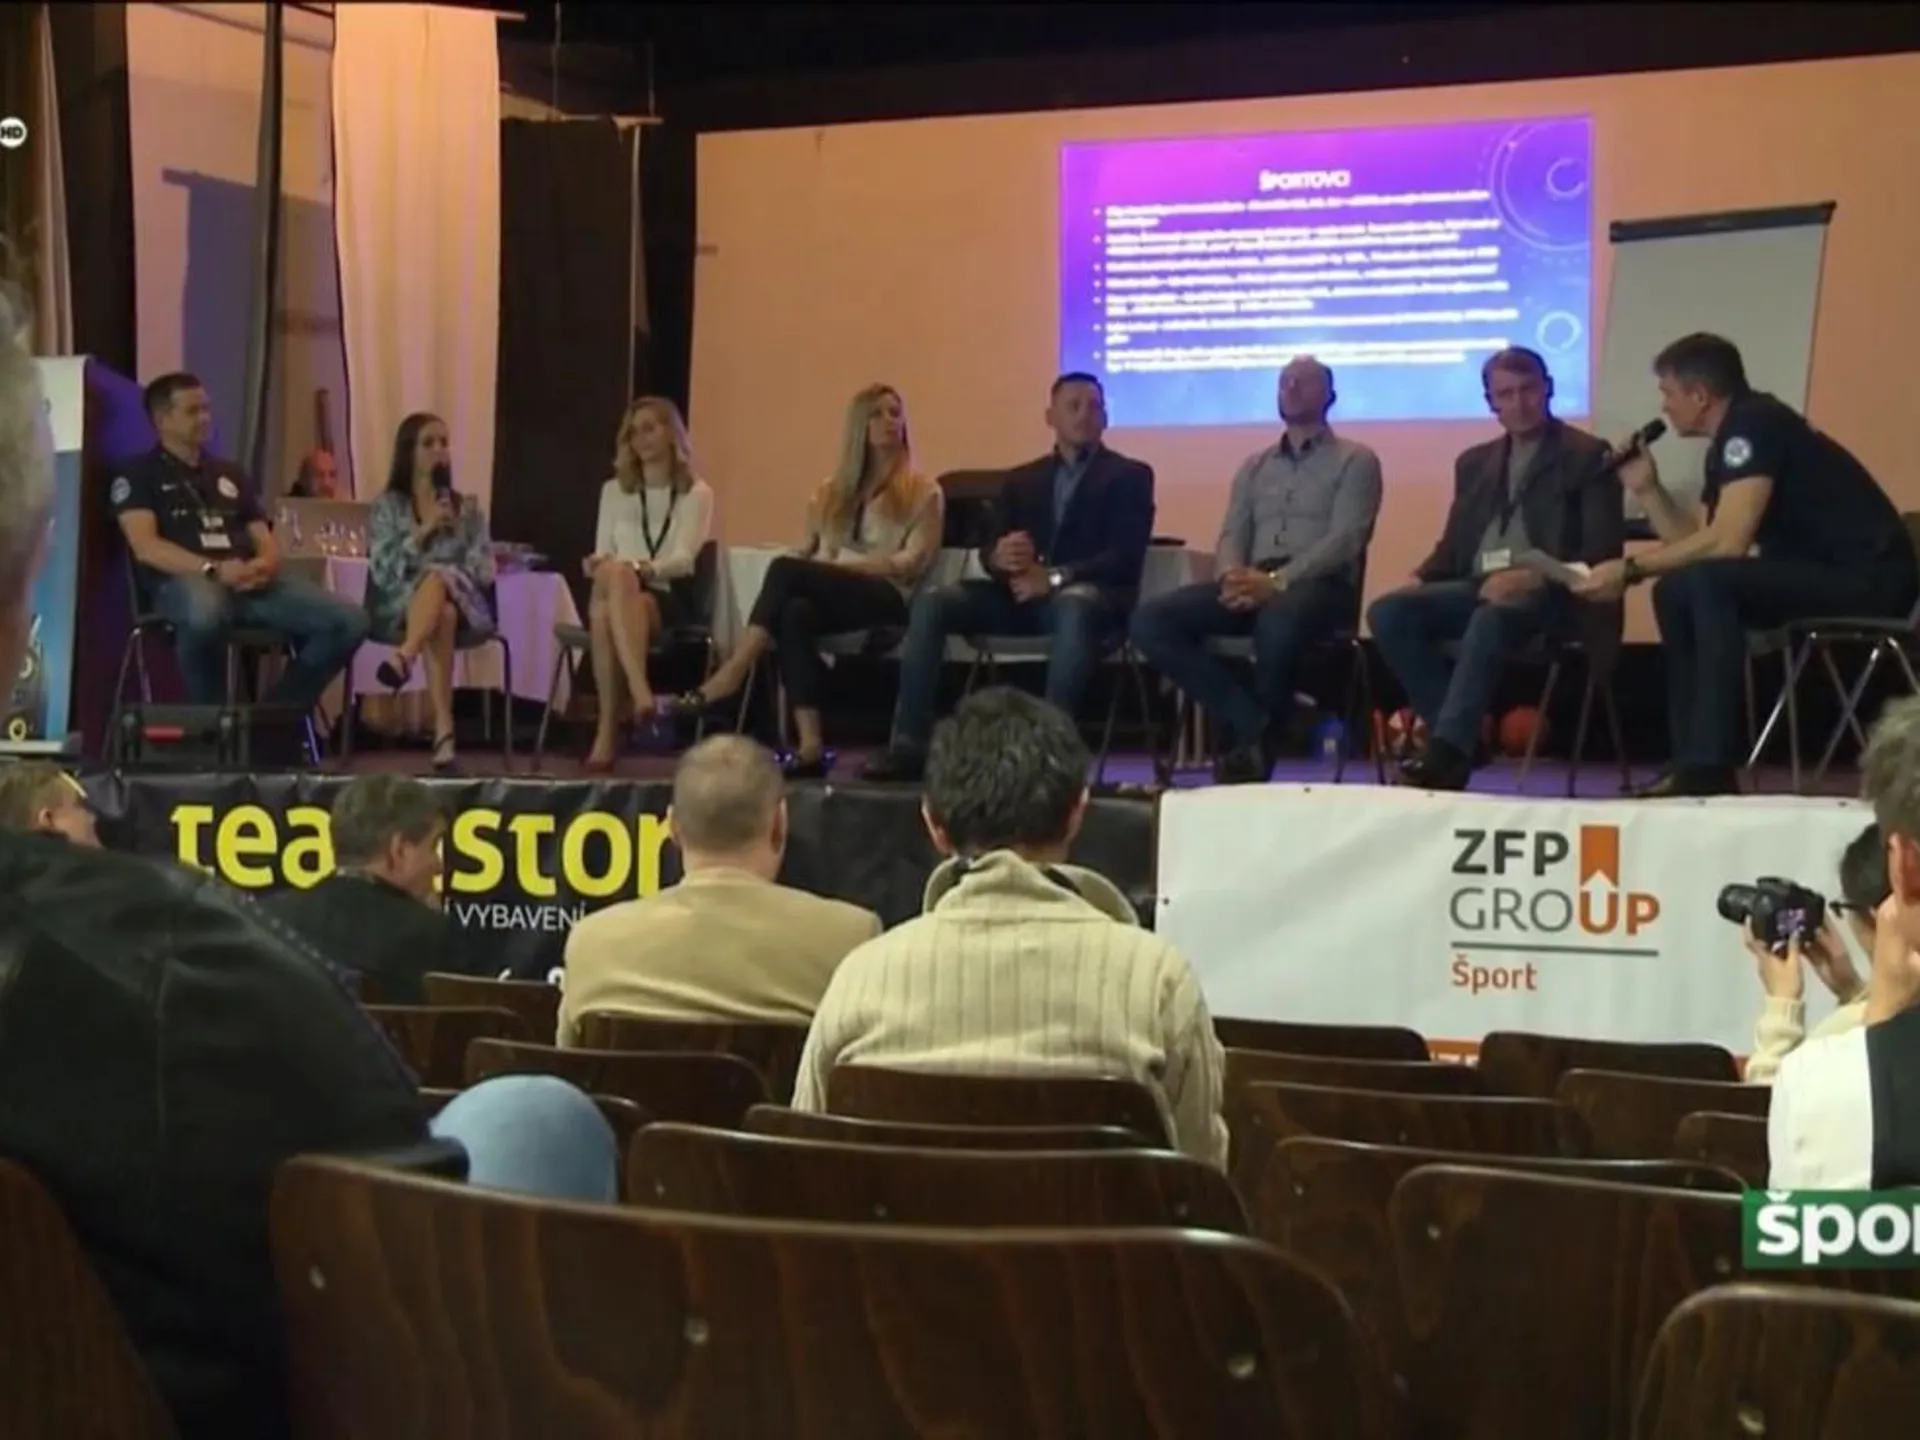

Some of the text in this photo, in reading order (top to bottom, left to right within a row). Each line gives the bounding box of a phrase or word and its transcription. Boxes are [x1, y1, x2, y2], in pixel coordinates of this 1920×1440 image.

[1451, 829, 1569, 877] ZFP
[1449, 886, 1660, 936] GROUP
[1452, 954, 1537, 995] Šport
